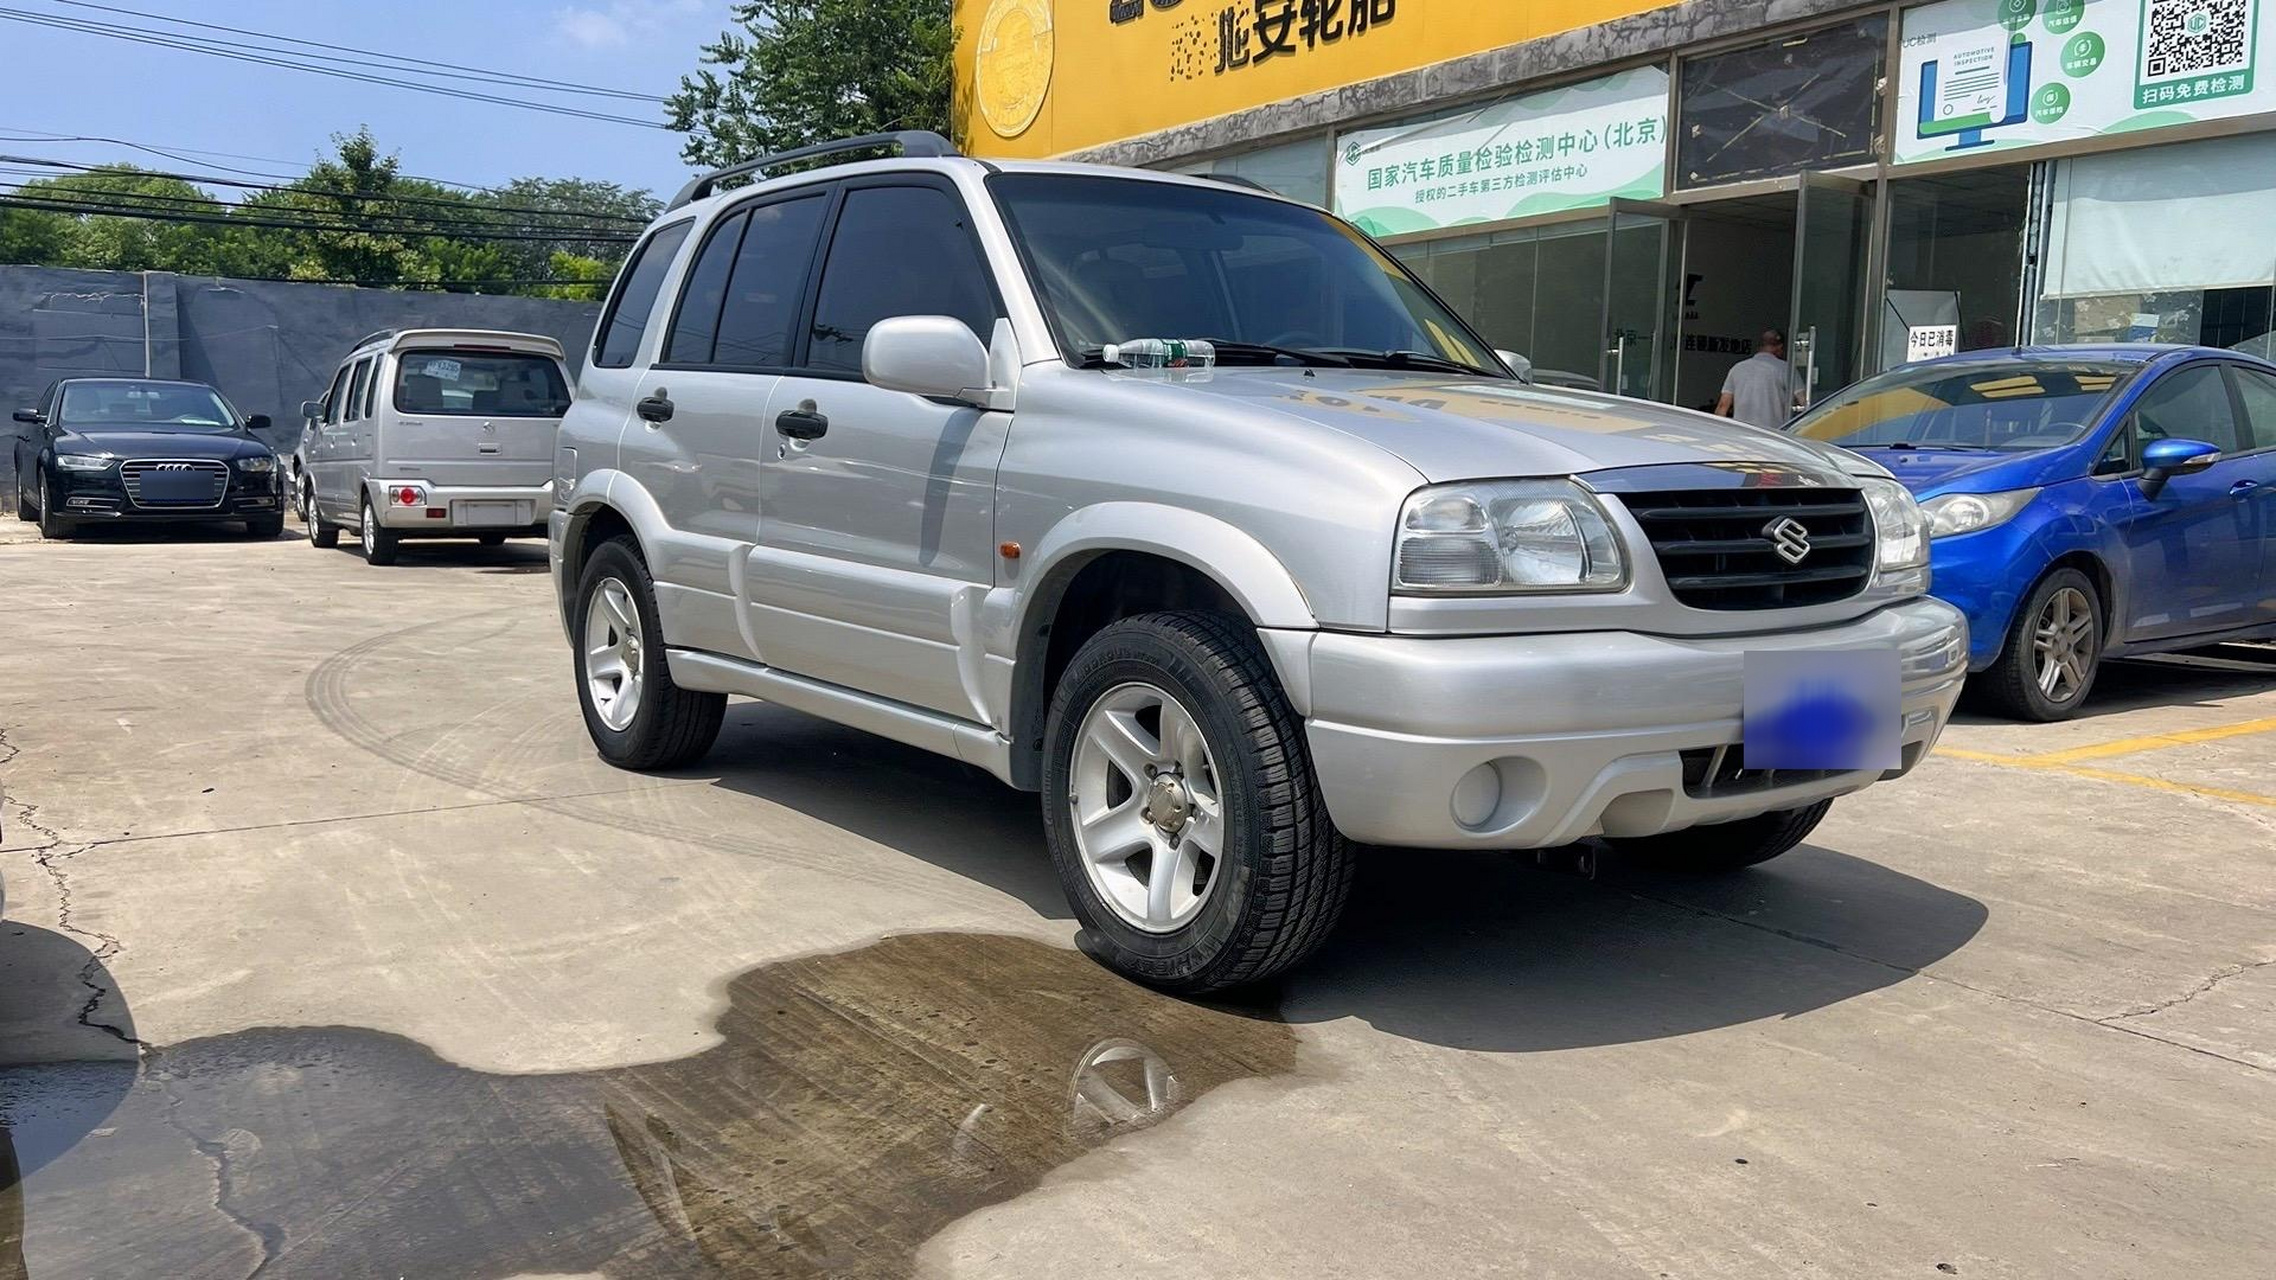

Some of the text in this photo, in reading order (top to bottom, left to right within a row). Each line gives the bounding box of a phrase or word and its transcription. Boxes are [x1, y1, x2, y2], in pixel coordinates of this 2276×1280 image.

[1953, 46, 1995, 60] AUTOMOTIVE
[1953, 54, 1993, 67] INSPECTION
[2142, 73, 2245, 104] 扫码免费检测
[1415, 163, 1588, 204] 授权的二手车第三方检测评估中心
[1910, 329, 1953, 348] 今日已消毒
